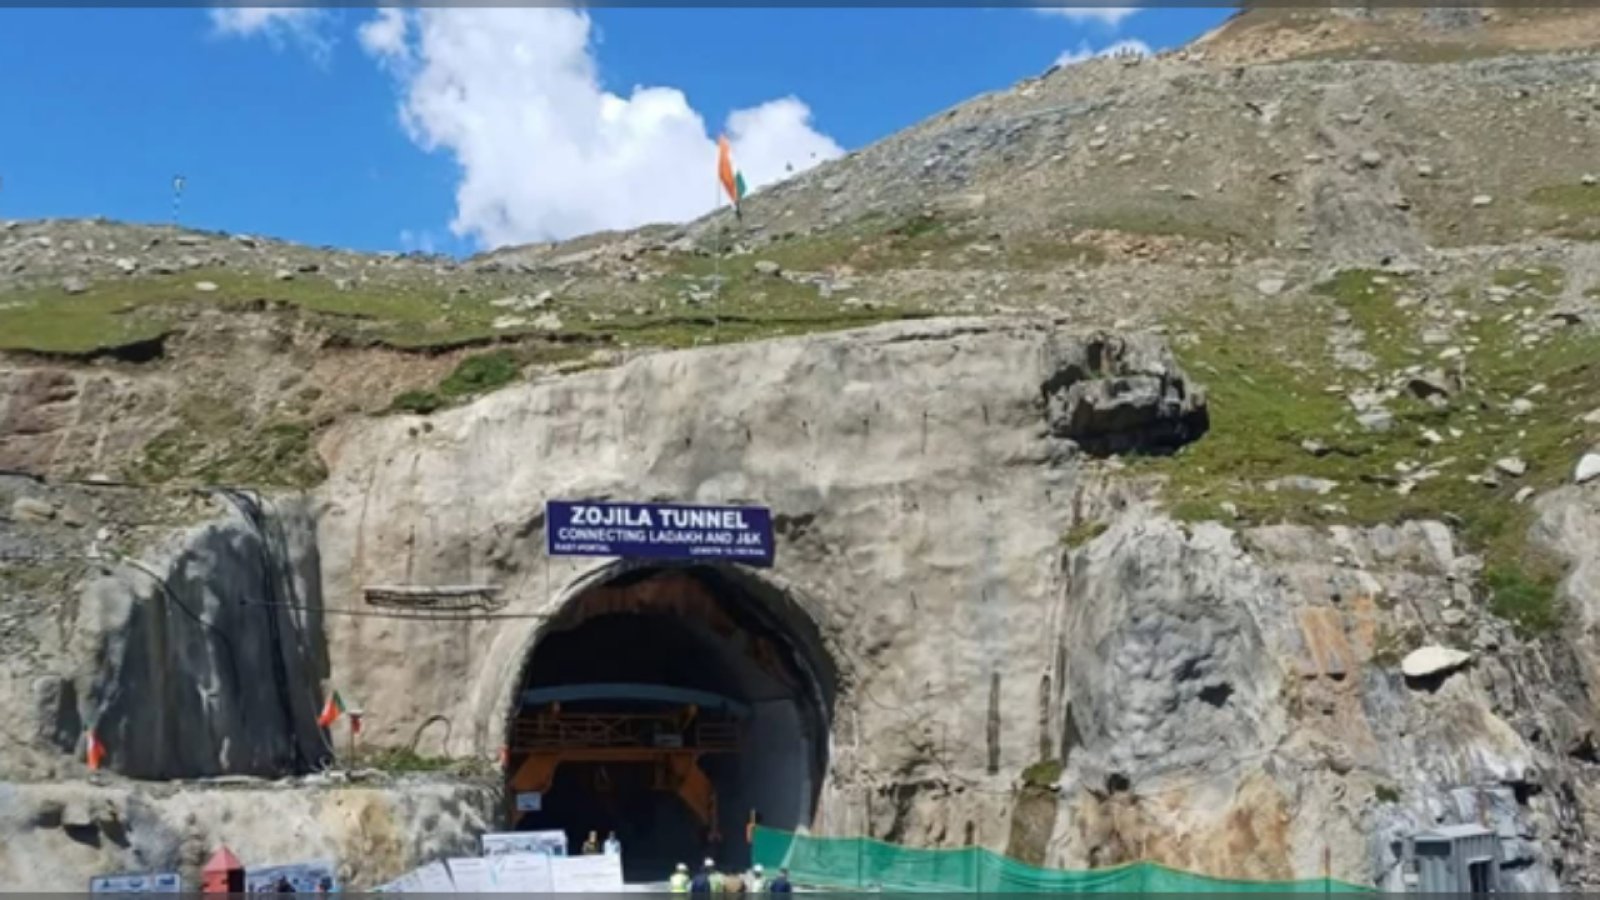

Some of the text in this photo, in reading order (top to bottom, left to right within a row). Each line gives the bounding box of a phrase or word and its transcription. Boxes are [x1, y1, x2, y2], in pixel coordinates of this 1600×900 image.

[571, 506, 748, 529] ZOJILA TUNNEL
[558, 527, 762, 546] CONNECTING LADAKH AND J&K
